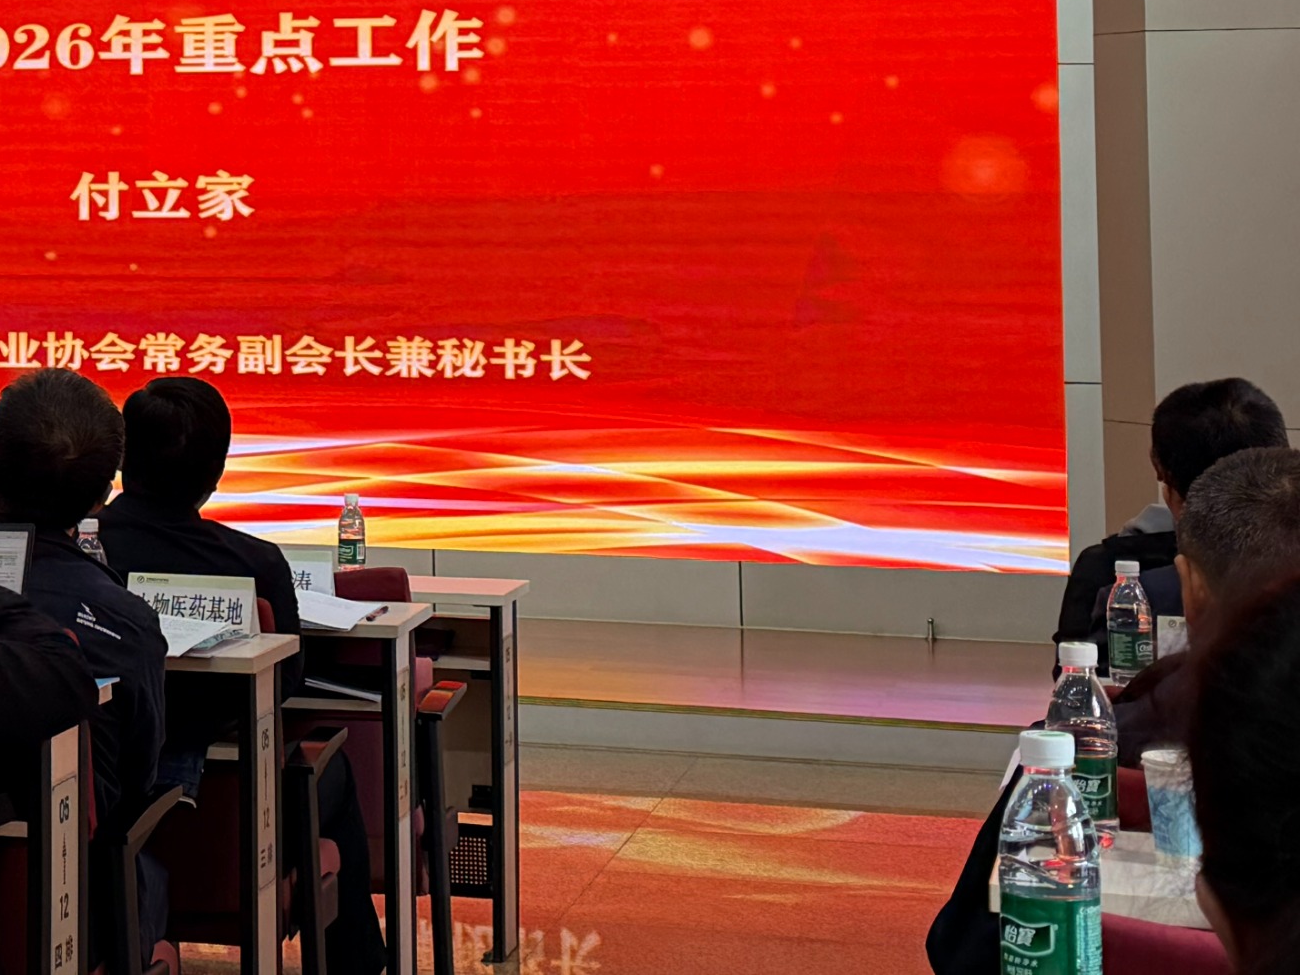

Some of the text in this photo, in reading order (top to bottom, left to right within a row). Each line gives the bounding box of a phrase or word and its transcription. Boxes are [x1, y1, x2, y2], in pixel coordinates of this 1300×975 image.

[70, 169, 255, 222] 付立家
[261, 727, 270, 751] 05
[59, 795, 71, 824] 05
[262, 806, 271, 831] 12
[59, 892, 71, 922] 12
